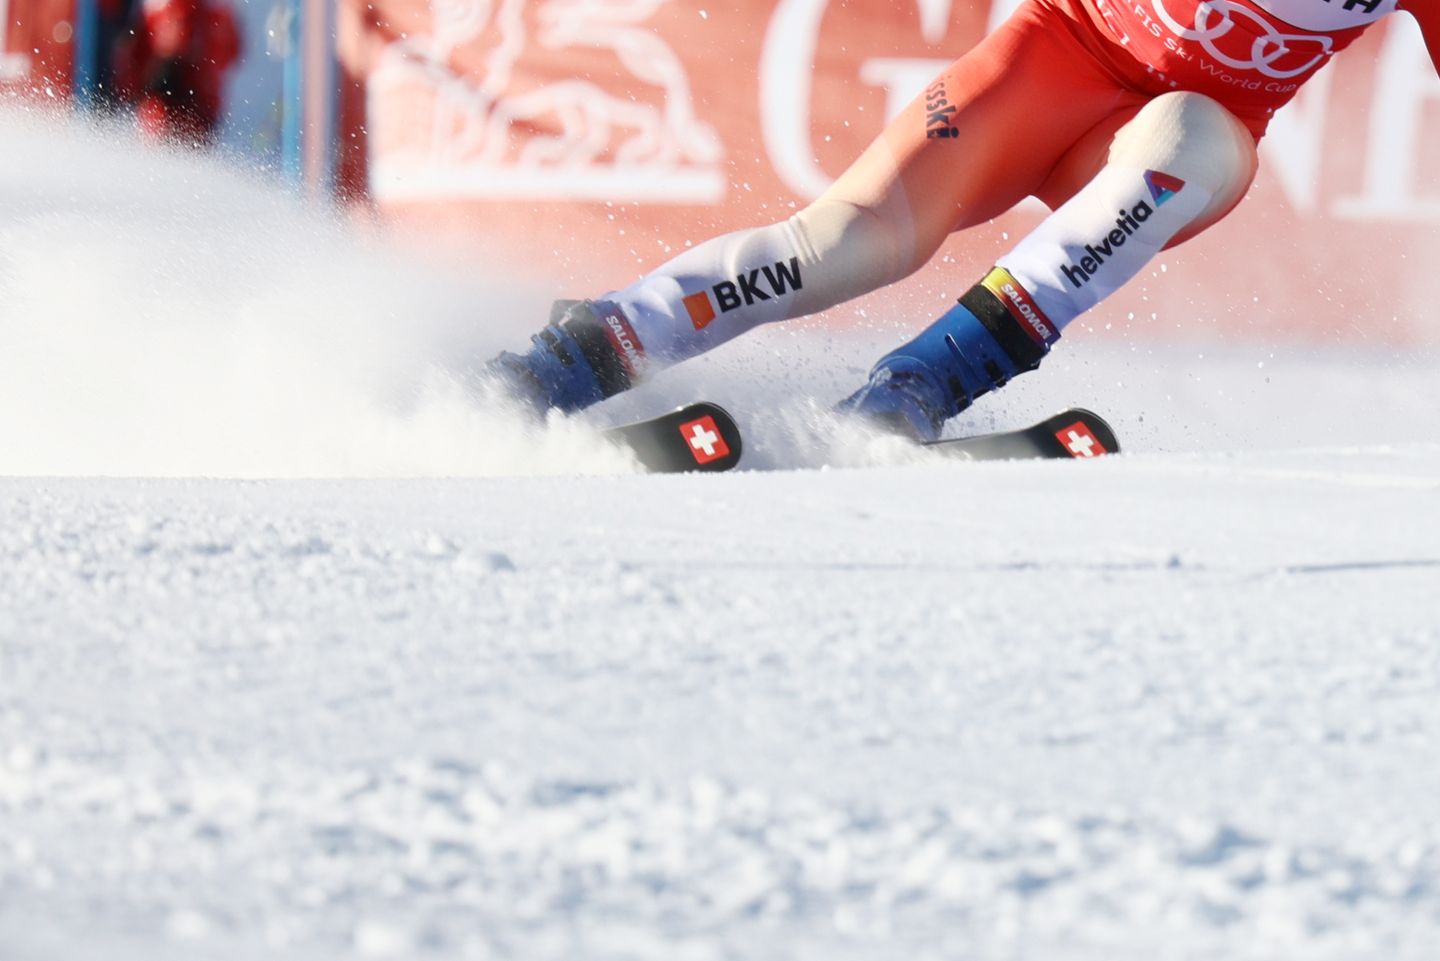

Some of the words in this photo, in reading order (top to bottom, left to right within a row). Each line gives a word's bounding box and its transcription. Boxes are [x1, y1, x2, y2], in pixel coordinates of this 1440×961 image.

[1134, 4, 1161, 37] FIS
[1163, 38, 1195, 63] Ski
[1200, 59, 1261, 91] World
[1264, 80, 1299, 94] Cup
[1059, 199, 1154, 289] helvetia
[711, 256, 804, 314] BKW
[1000, 283, 1053, 341] SALOMON
